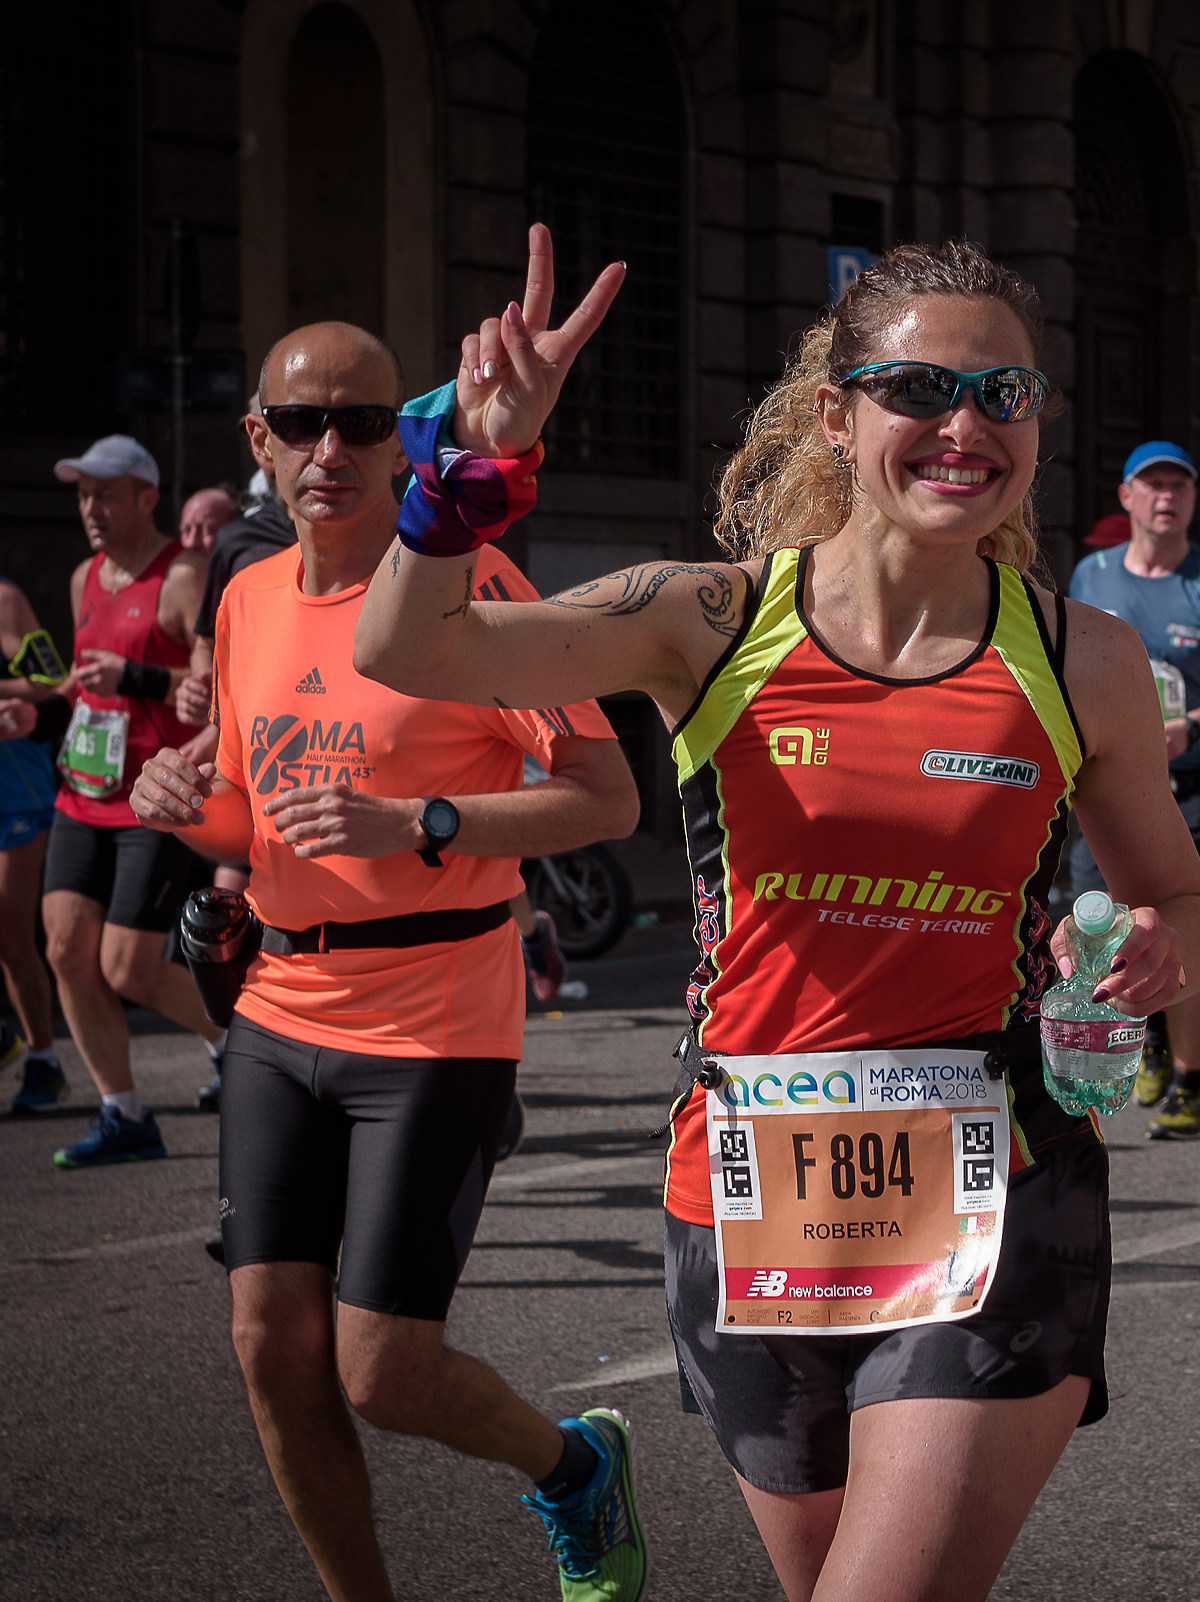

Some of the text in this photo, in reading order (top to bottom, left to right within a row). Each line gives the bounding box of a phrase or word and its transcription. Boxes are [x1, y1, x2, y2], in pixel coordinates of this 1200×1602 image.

[296, 685, 326, 694] adidas
[325, 755, 366, 764] MARATHON
[818, 909, 914, 931] TELESE
[869, 1065, 983, 1084] MARATONA
[724, 1070, 855, 1108] acea
[869, 1083, 987, 1102] di ROMA 2018
[792, 1131, 915, 1200] F 894
[803, 1221, 902, 1240] ROBERTA
[789, 1286, 813, 1297] new
[814, 1284, 873, 1298] balance
[777, 1310, 793, 1324] F2
[869, 1310, 880, 1323] C
